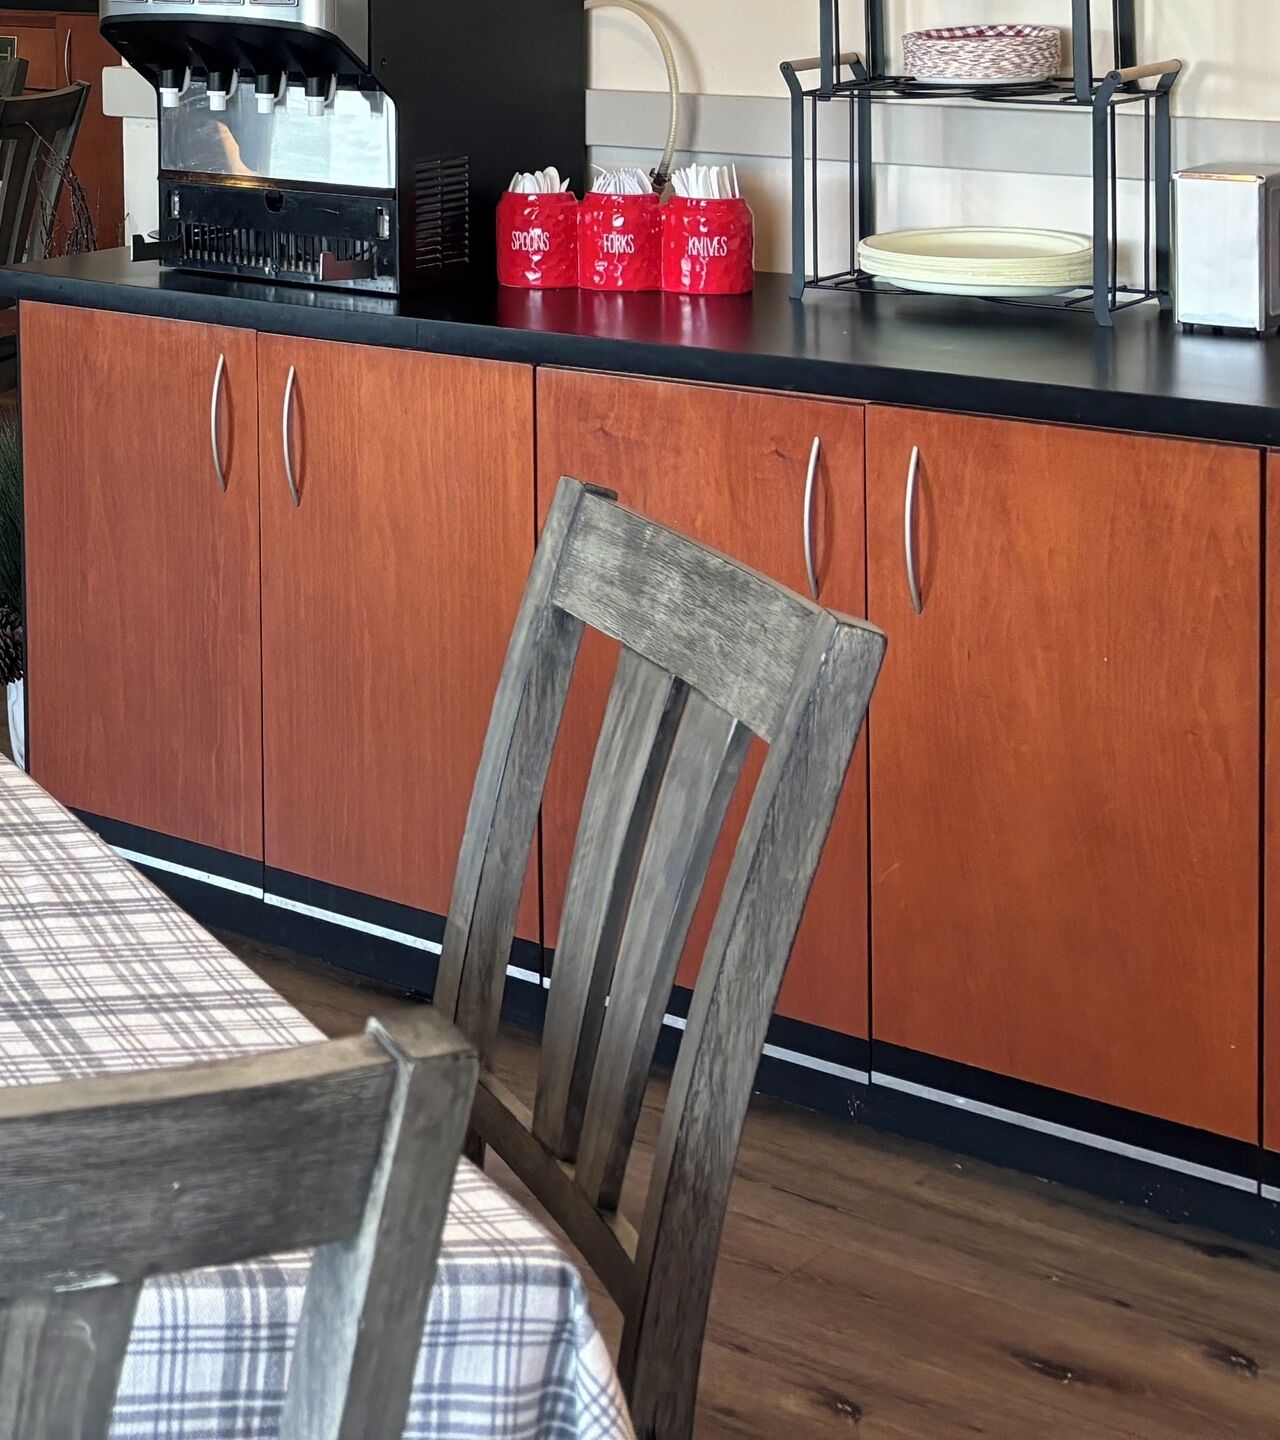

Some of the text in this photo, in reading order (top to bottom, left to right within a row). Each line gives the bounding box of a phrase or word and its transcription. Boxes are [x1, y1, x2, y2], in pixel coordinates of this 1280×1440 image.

[511, 231, 550, 252] SPOONS
[603, 233, 635, 254] FORKS
[688, 236, 728, 257] KNIVES
